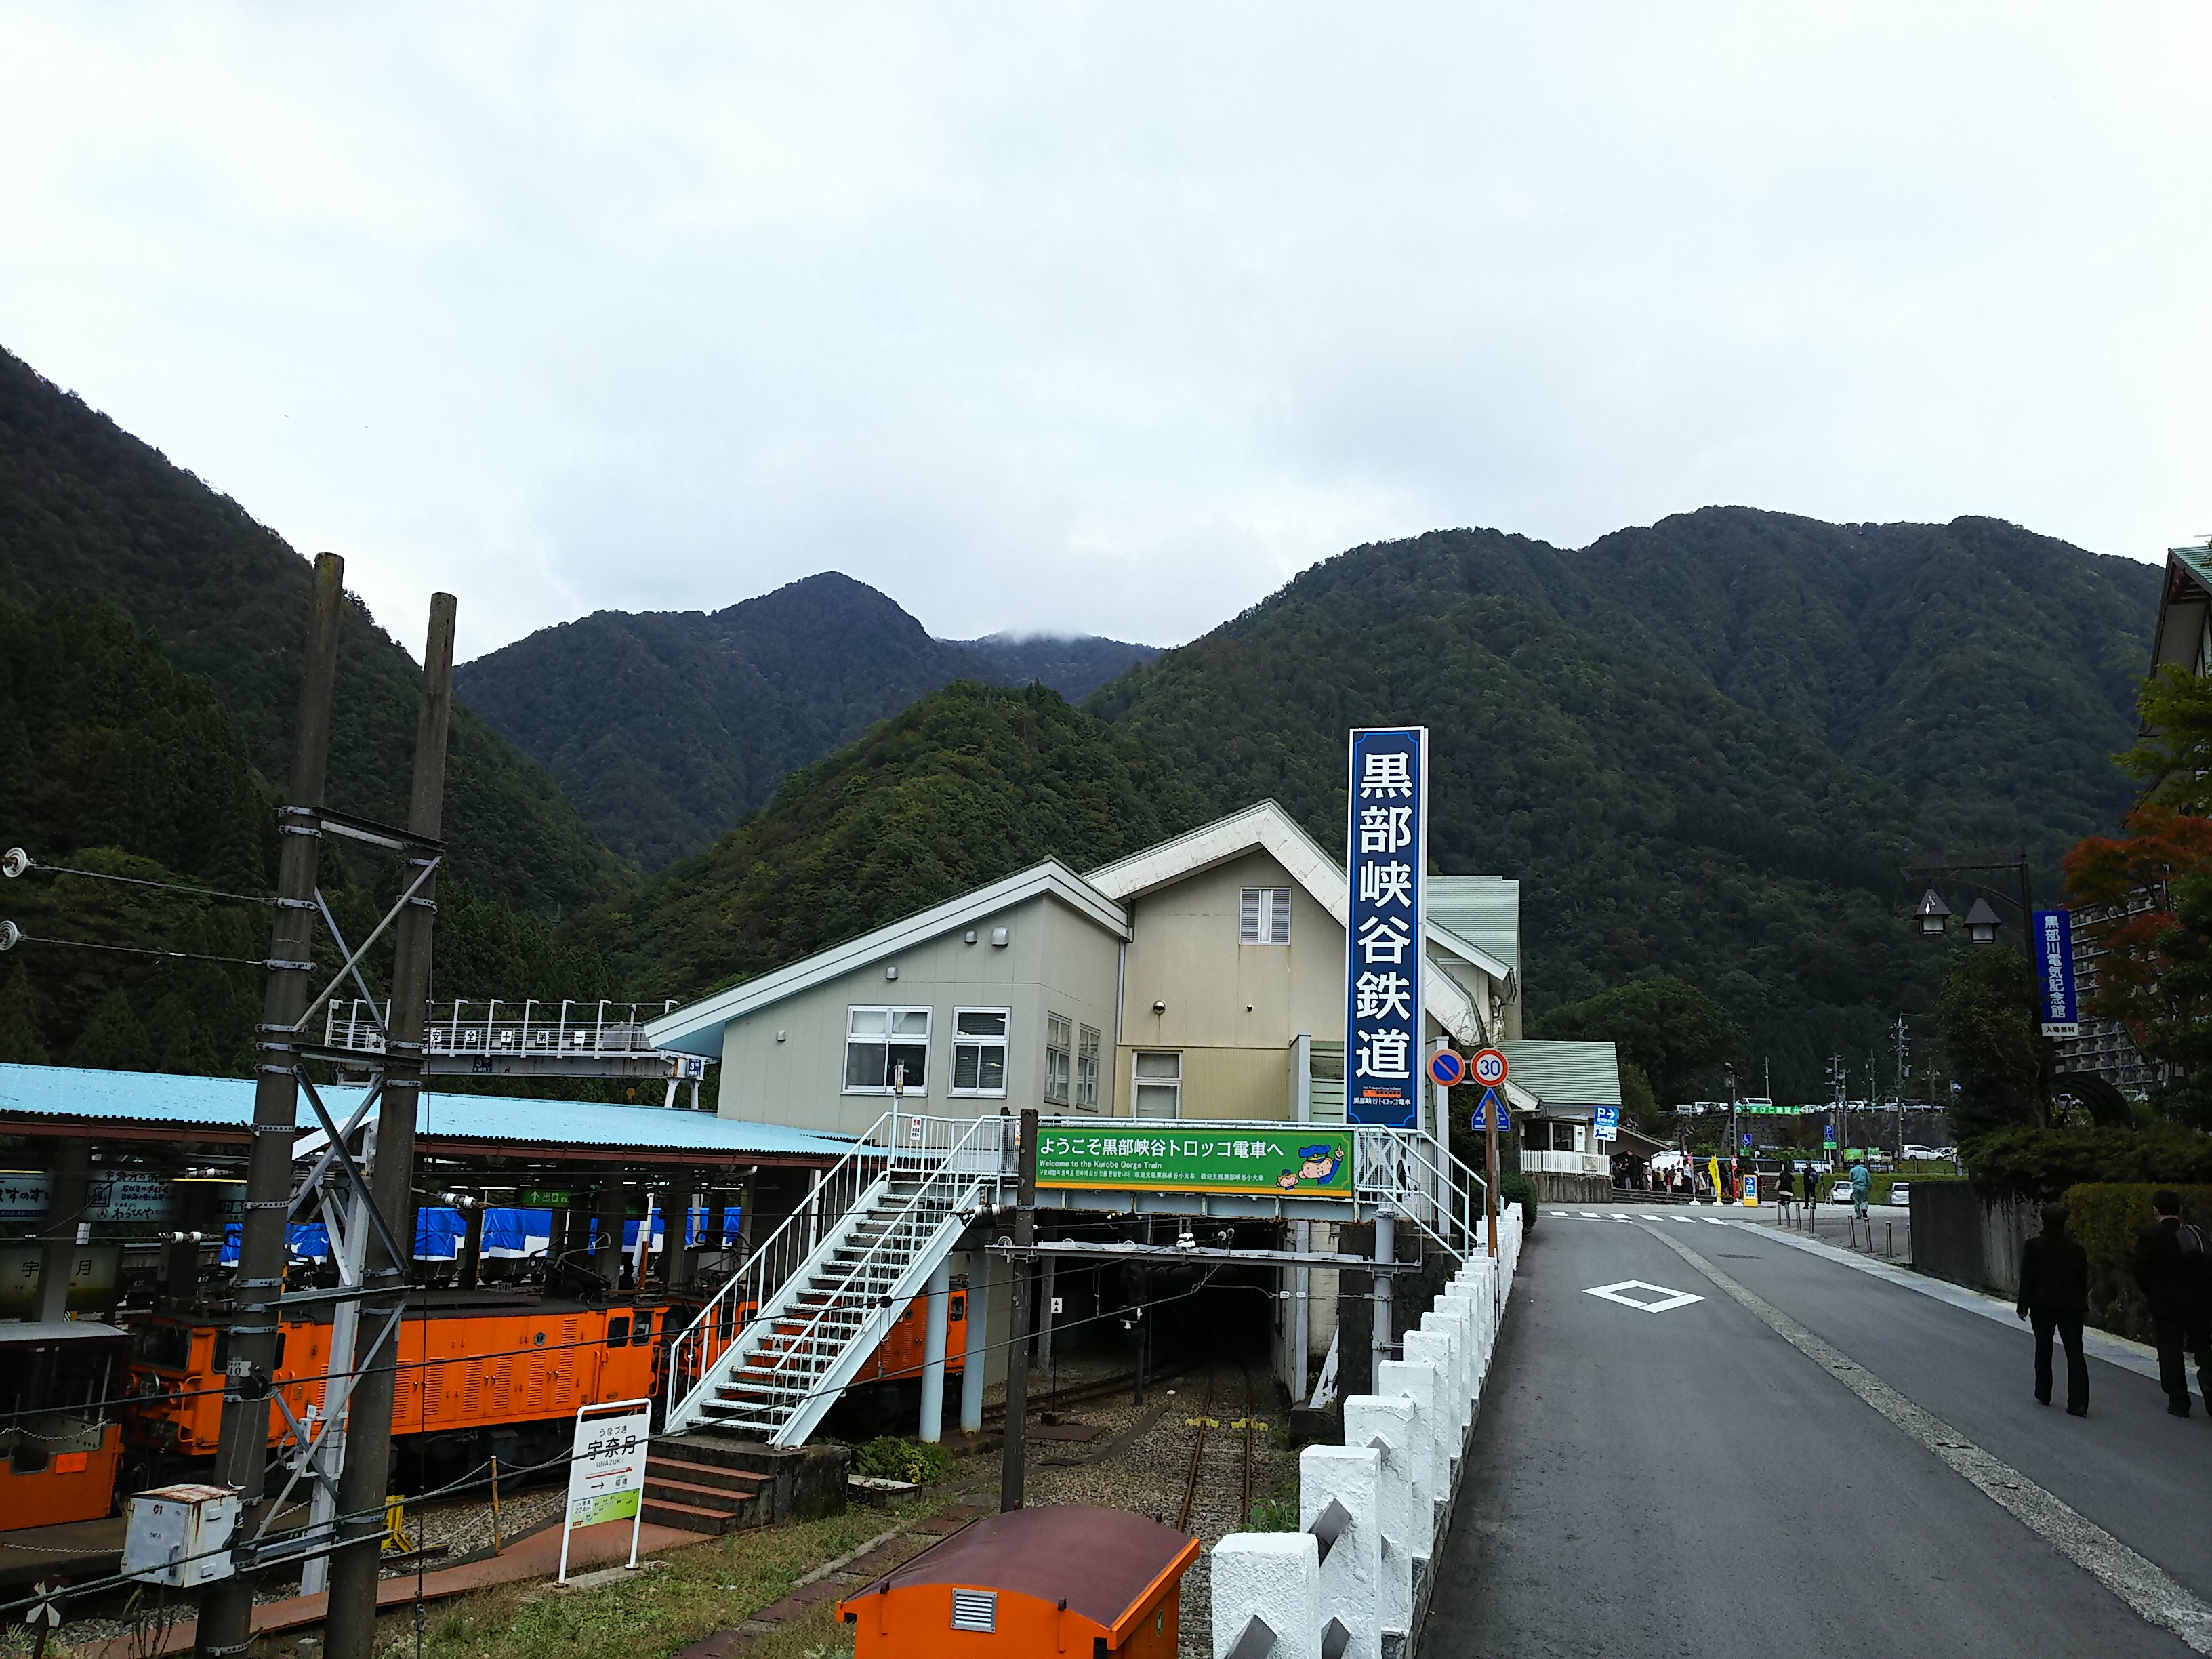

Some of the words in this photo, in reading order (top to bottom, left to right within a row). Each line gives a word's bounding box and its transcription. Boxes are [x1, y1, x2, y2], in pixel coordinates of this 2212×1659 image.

[1355, 751, 1412, 1079] 黒部峡谷鉄道
[2044, 916, 2066, 1018] 黒部川電気記念館
[1480, 1059, 1500, 1076] 30
[1597, 1107, 1605, 1118] P
[1040, 1137, 1284, 1160] ようこそ黒部峡谷トロッコ電車へ
[1039, 1159, 1069, 1167] Welcome
[1080, 1160, 1092, 1168] the
[1093, 1160, 1119, 1168] Kurobe
[1120, 1161, 1142, 1170] Gorge
[1144, 1161, 1162, 1169] Train
[1746, 1185, 1754, 1193] P
[600, 1425, 628, 1437] うなづき
[588, 1435, 636, 1460] 宇奈月
[596, 1458, 624, 1468] UNAZUKI
[153, 1504, 163, 1515] C1
